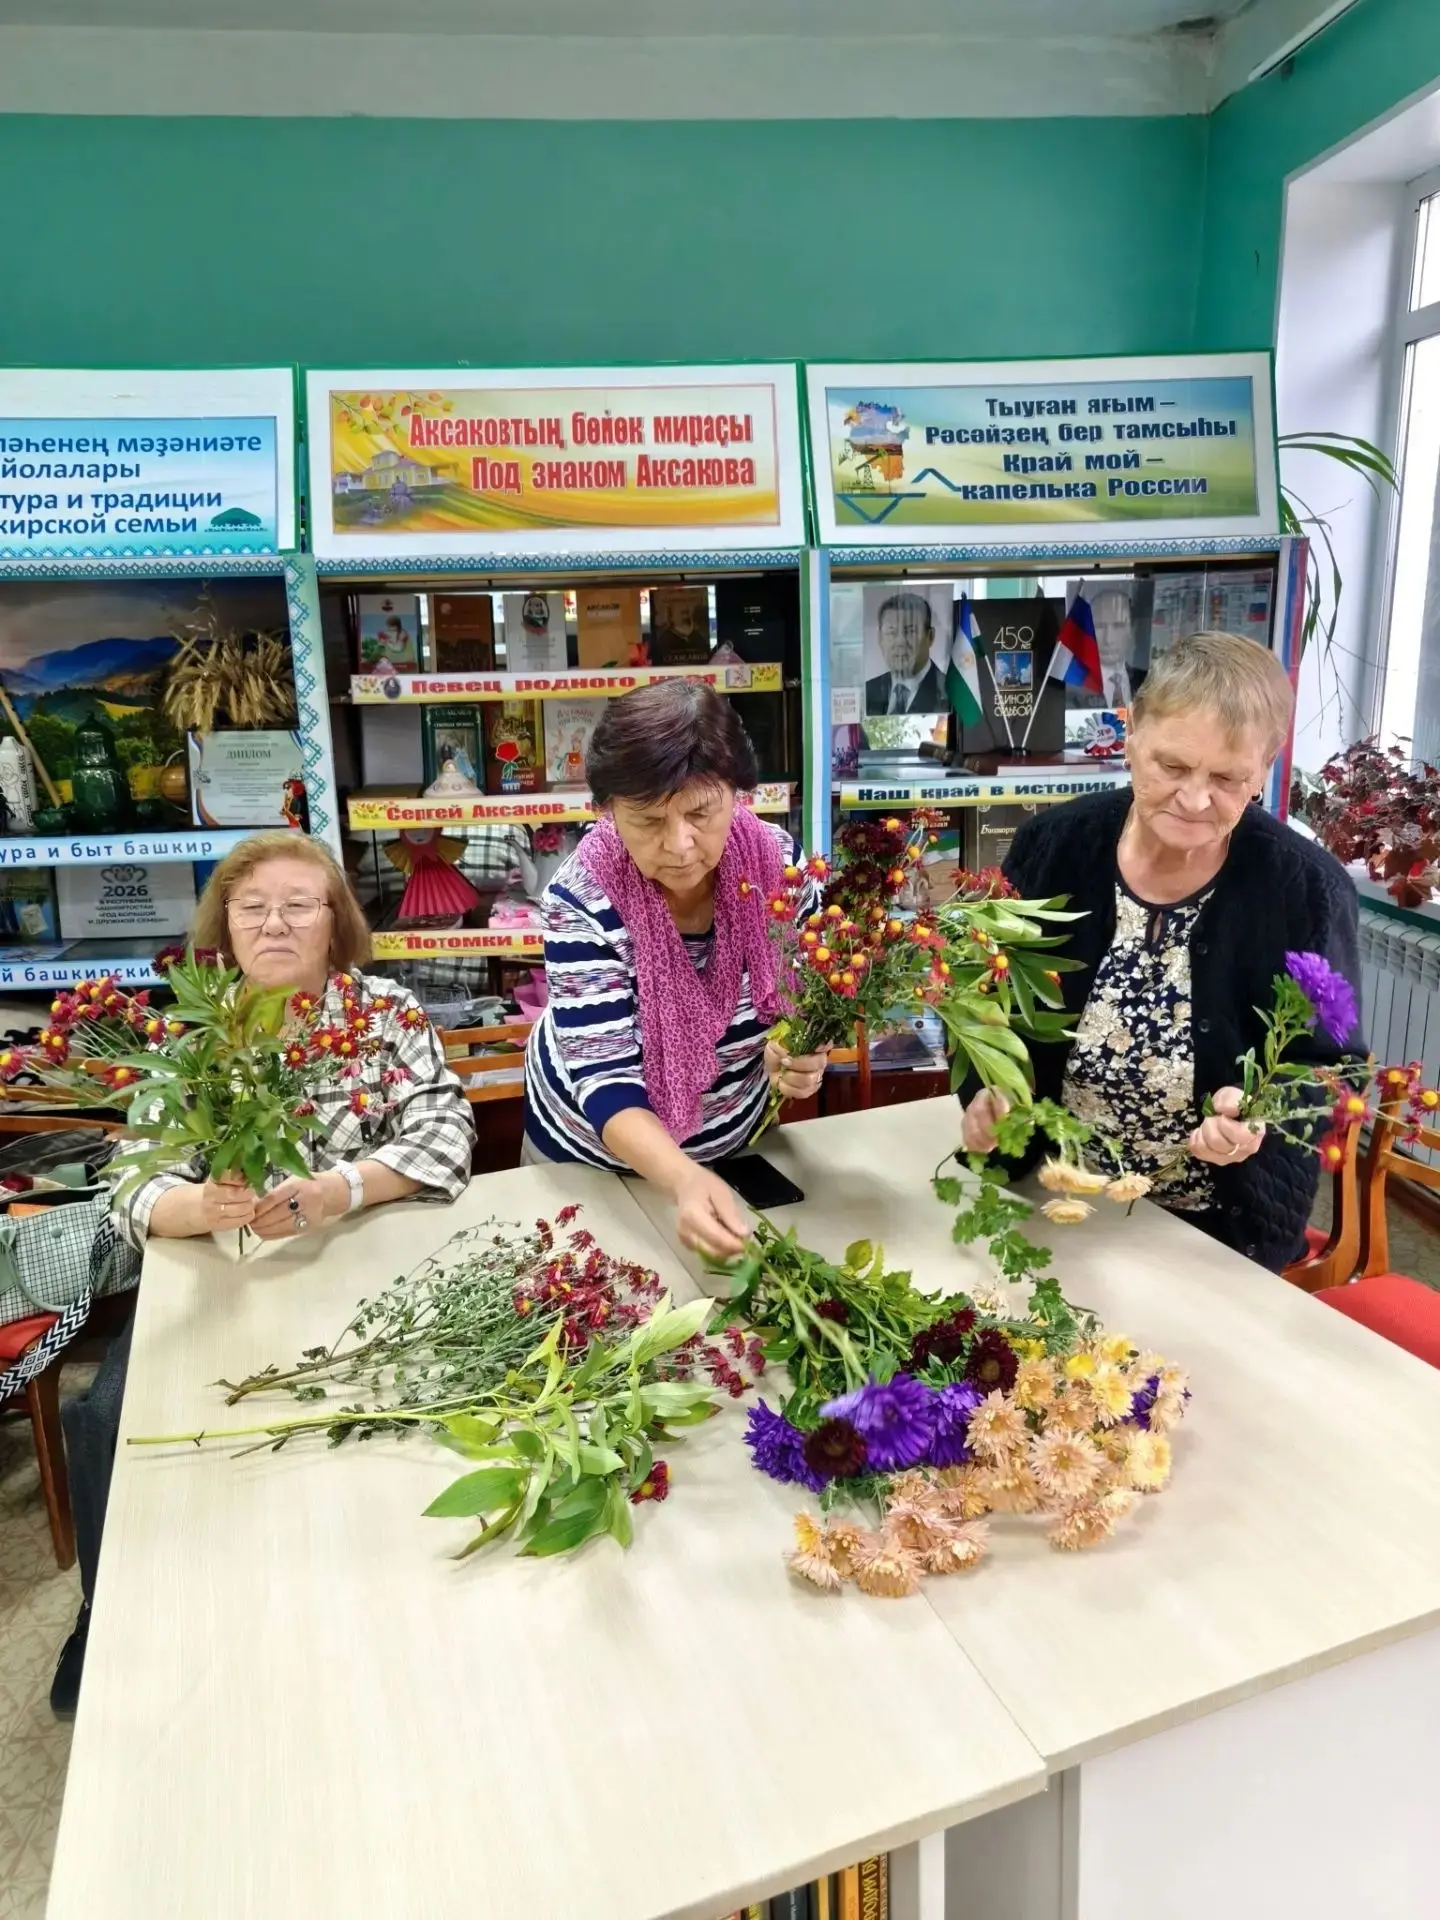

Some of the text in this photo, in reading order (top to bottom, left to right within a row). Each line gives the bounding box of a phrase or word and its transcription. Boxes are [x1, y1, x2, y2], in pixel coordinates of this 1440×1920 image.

[985, 396, 1076, 420] Тыуған
[1087, 396, 1154, 414] яғым
[408, 411, 752, 450] Аксаковтың бөйөк мираҫы
[924, 417, 1236, 447] Рәсәйҙең бер тамсыһы
[117, 436, 262, 457] мәҙәниәте
[2, 457, 140, 483] йолалары
[1002, 451, 1072, 474] Край
[1084, 450, 1140, 470] мой
[471, 454, 755, 494] Под знаком Аксакова
[961, 477, 1208, 500] капелька России
[67, 494, 83, 508] и
[90, 492, 222, 513] традиции
[114, 516, 197, 534] семьи
[993, 626, 1034, 650] 450
[411, 679, 502, 695] Певец
[515, 675, 636, 692] родного
[225, 749, 271, 760] ДИПЛОМ
[858, 781, 1116, 801] Наш край в истории
[387, 805, 463, 821] Сергей
[472, 802, 565, 818] Аксаков
[48, 847, 60, 858] и
[71, 842, 113, 858] быт
[124, 840, 212, 856] башкир
[103, 885, 148, 897] 2026
[406, 935, 512, 949] Потомки
[24, 967, 150, 982] башкирски
